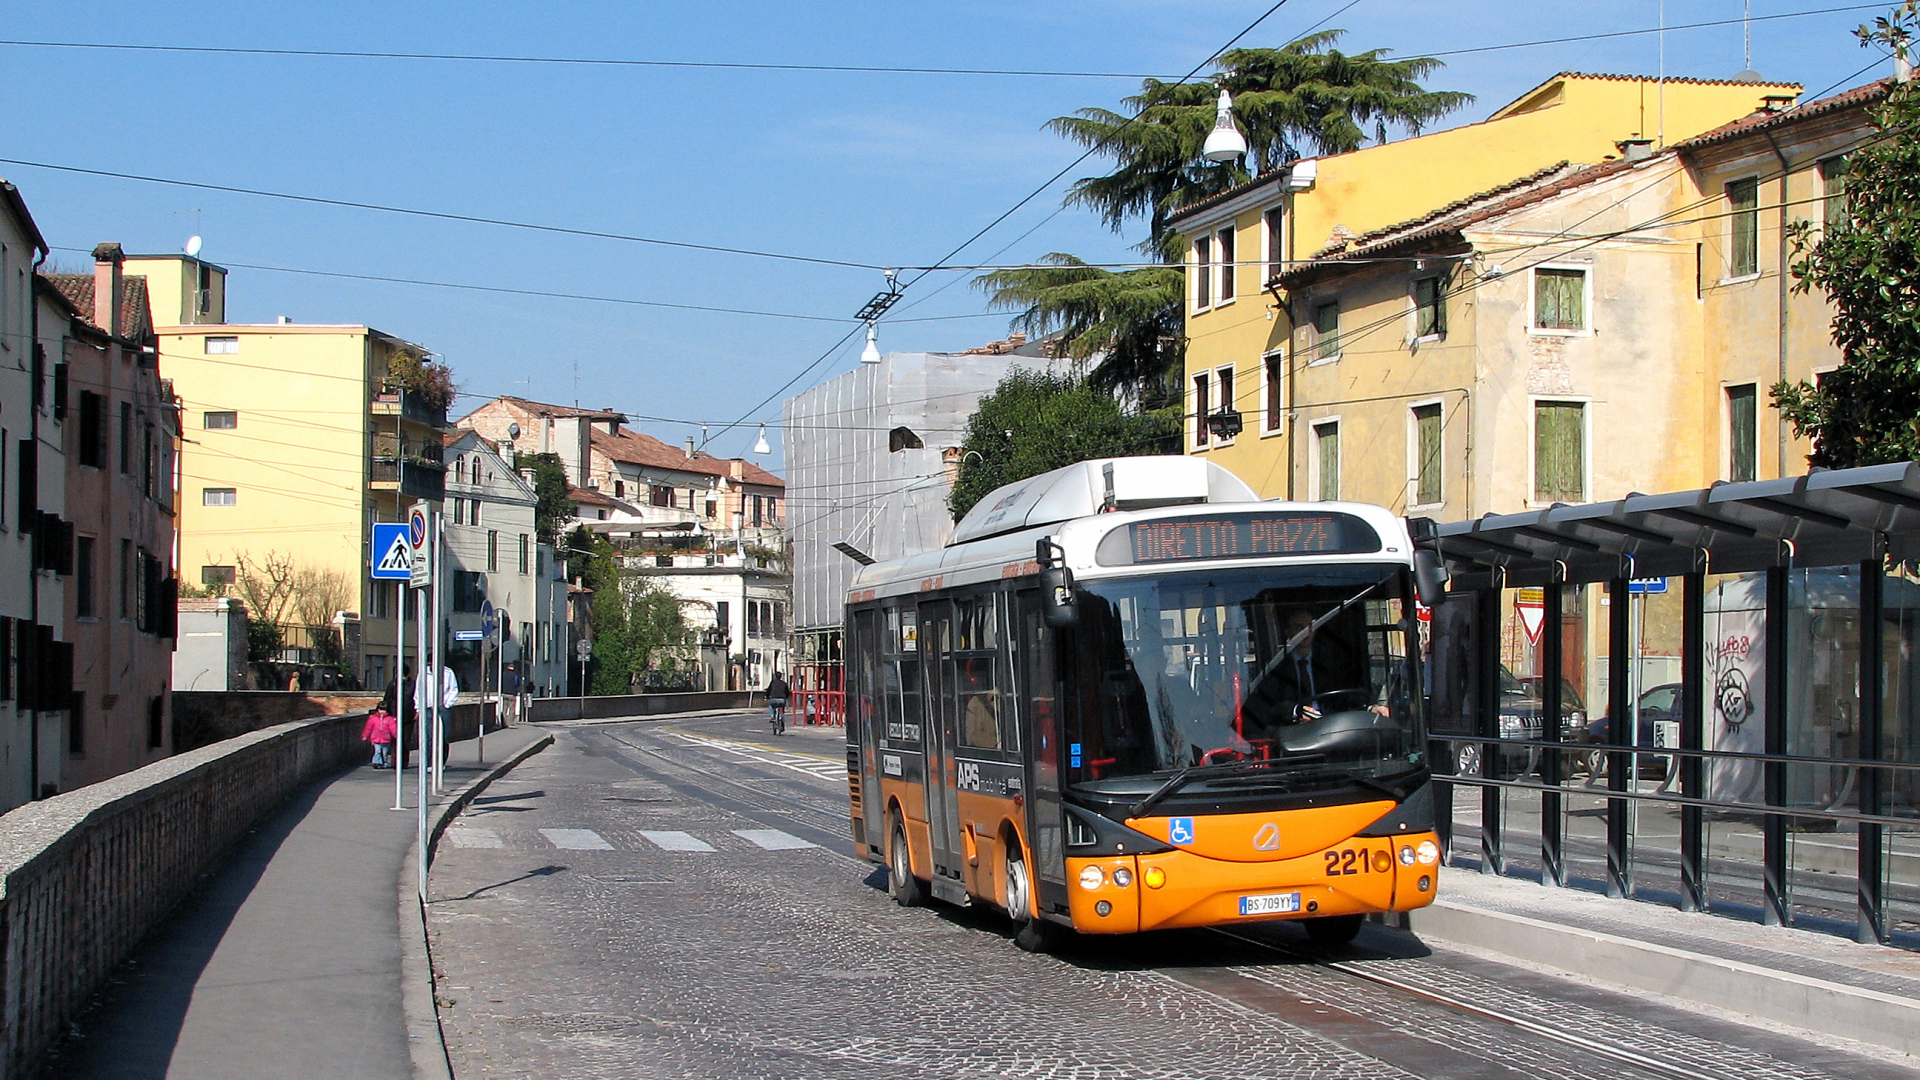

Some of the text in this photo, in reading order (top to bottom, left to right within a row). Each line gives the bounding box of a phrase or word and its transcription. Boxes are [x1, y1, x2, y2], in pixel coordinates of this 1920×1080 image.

[1136, 520, 1237, 560] DIRETTO
[957, 762, 980, 791] APS
[1324, 848, 1369, 876] 221
